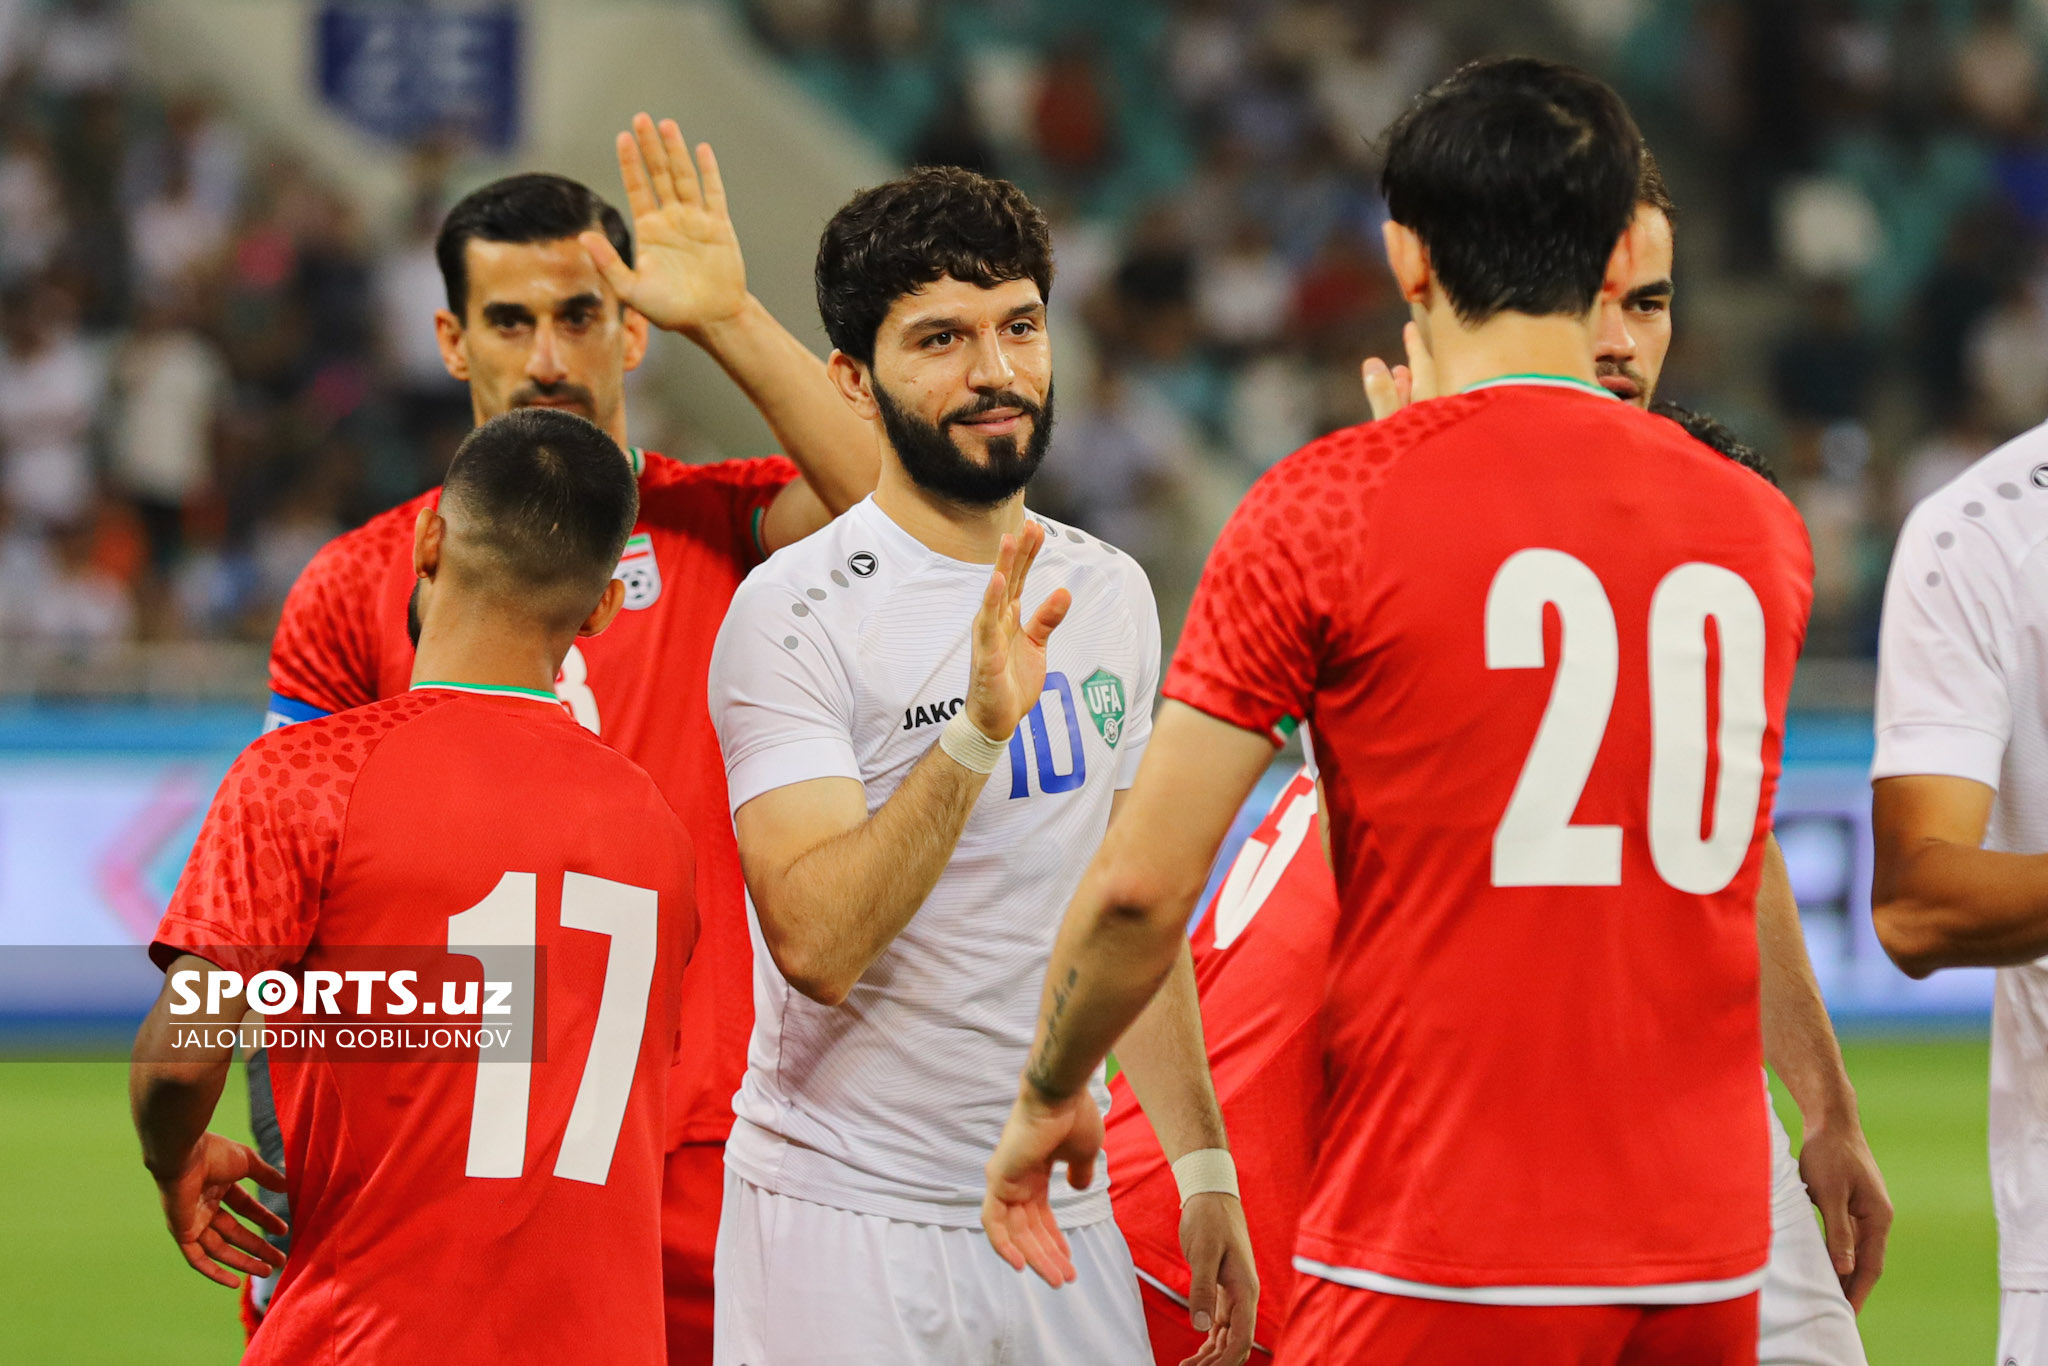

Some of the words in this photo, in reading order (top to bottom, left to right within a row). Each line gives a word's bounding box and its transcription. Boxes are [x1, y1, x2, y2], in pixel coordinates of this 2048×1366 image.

[1009, 671, 1086, 800] 10
[1087, 684, 1123, 715] UFA
[1485, 548, 1767, 895] 20
[448, 871, 659, 1186] 17
